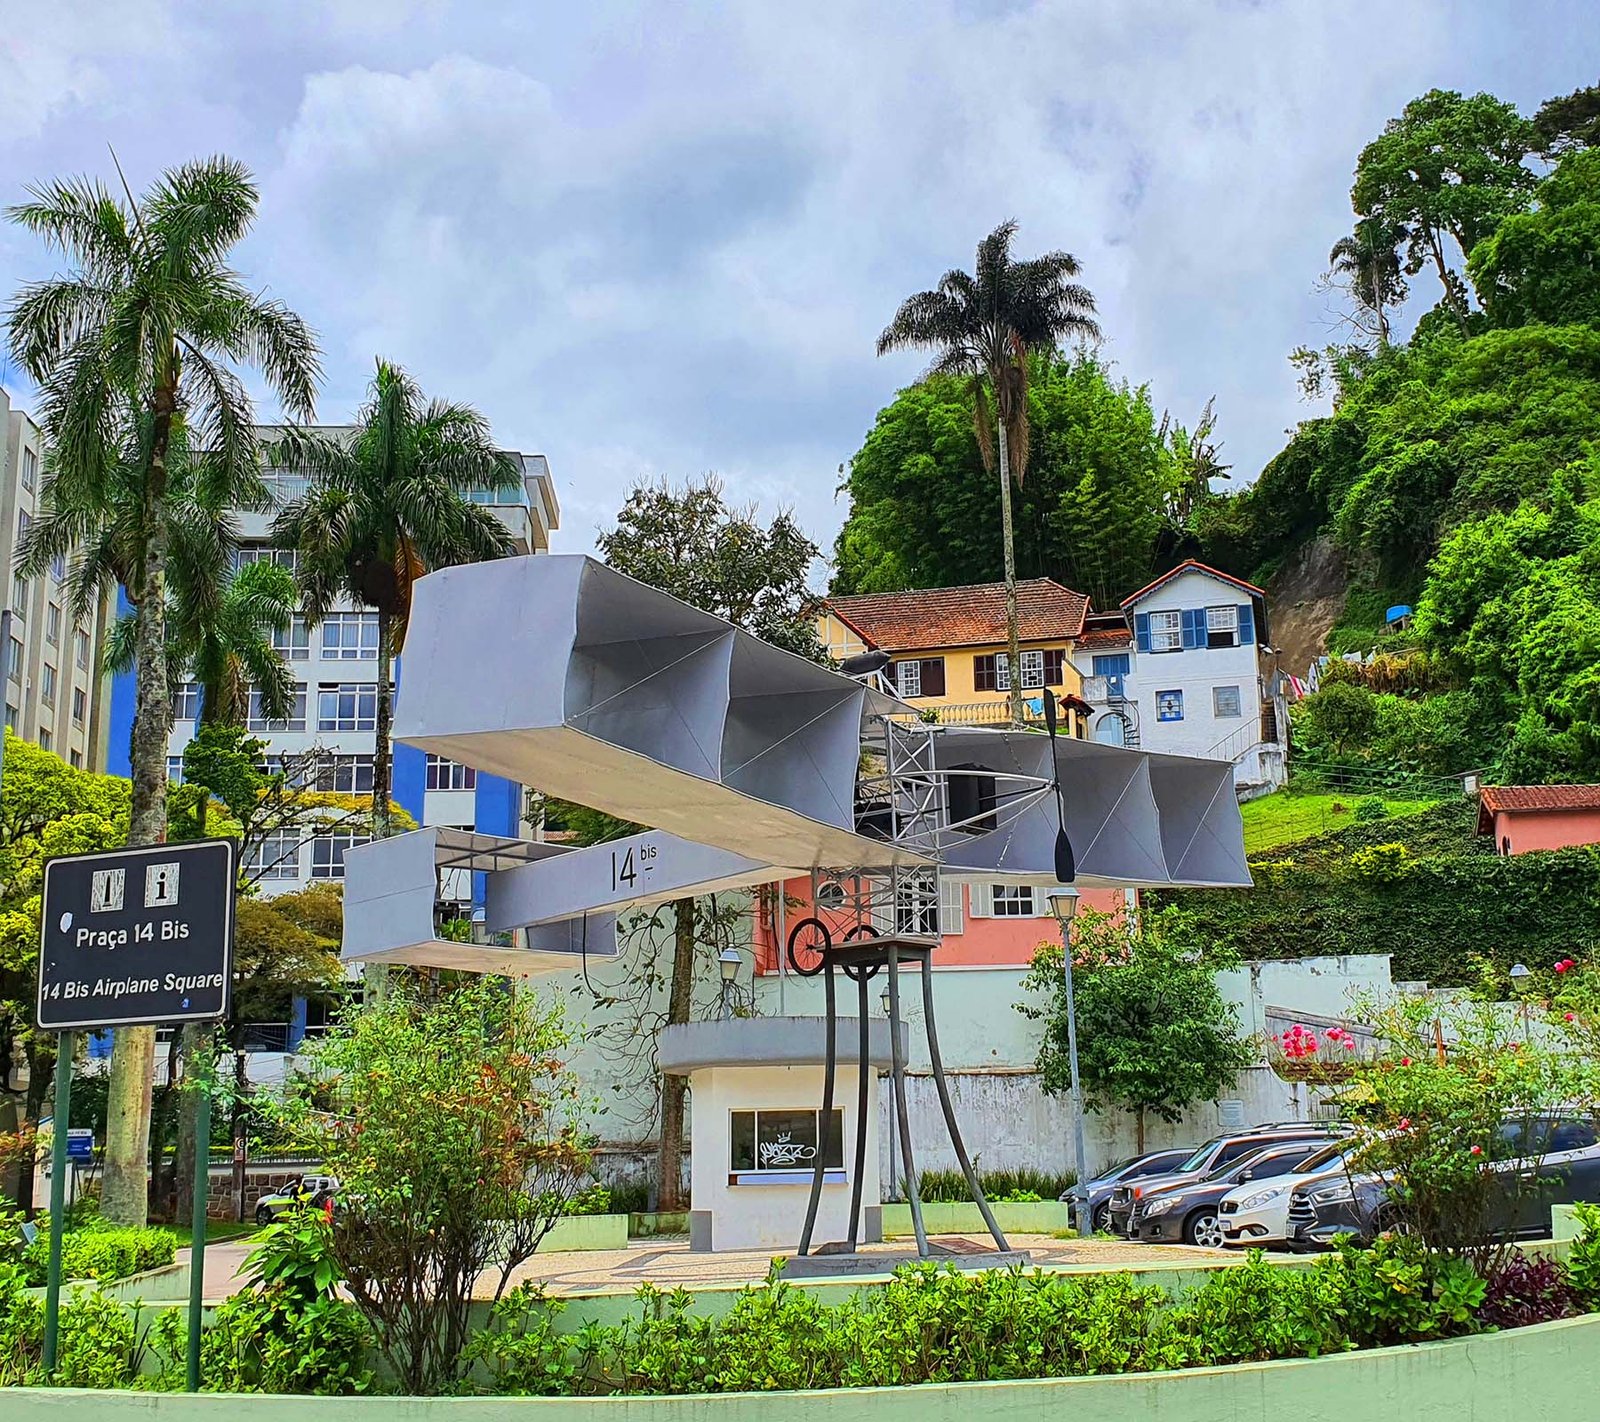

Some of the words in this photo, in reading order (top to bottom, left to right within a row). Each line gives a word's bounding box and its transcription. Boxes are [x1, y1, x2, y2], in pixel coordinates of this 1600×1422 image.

[612, 847, 637, 891] 14
[640, 843, 657, 860] bis
[76, 927, 127, 950] Praça
[134, 921, 154, 943] 14
[161, 920, 190, 940] Bis
[42, 983, 60, 1000] 14
[64, 980, 89, 999] Bis
[92, 976, 159, 999] Airplane
[163, 973, 223, 994] Square
